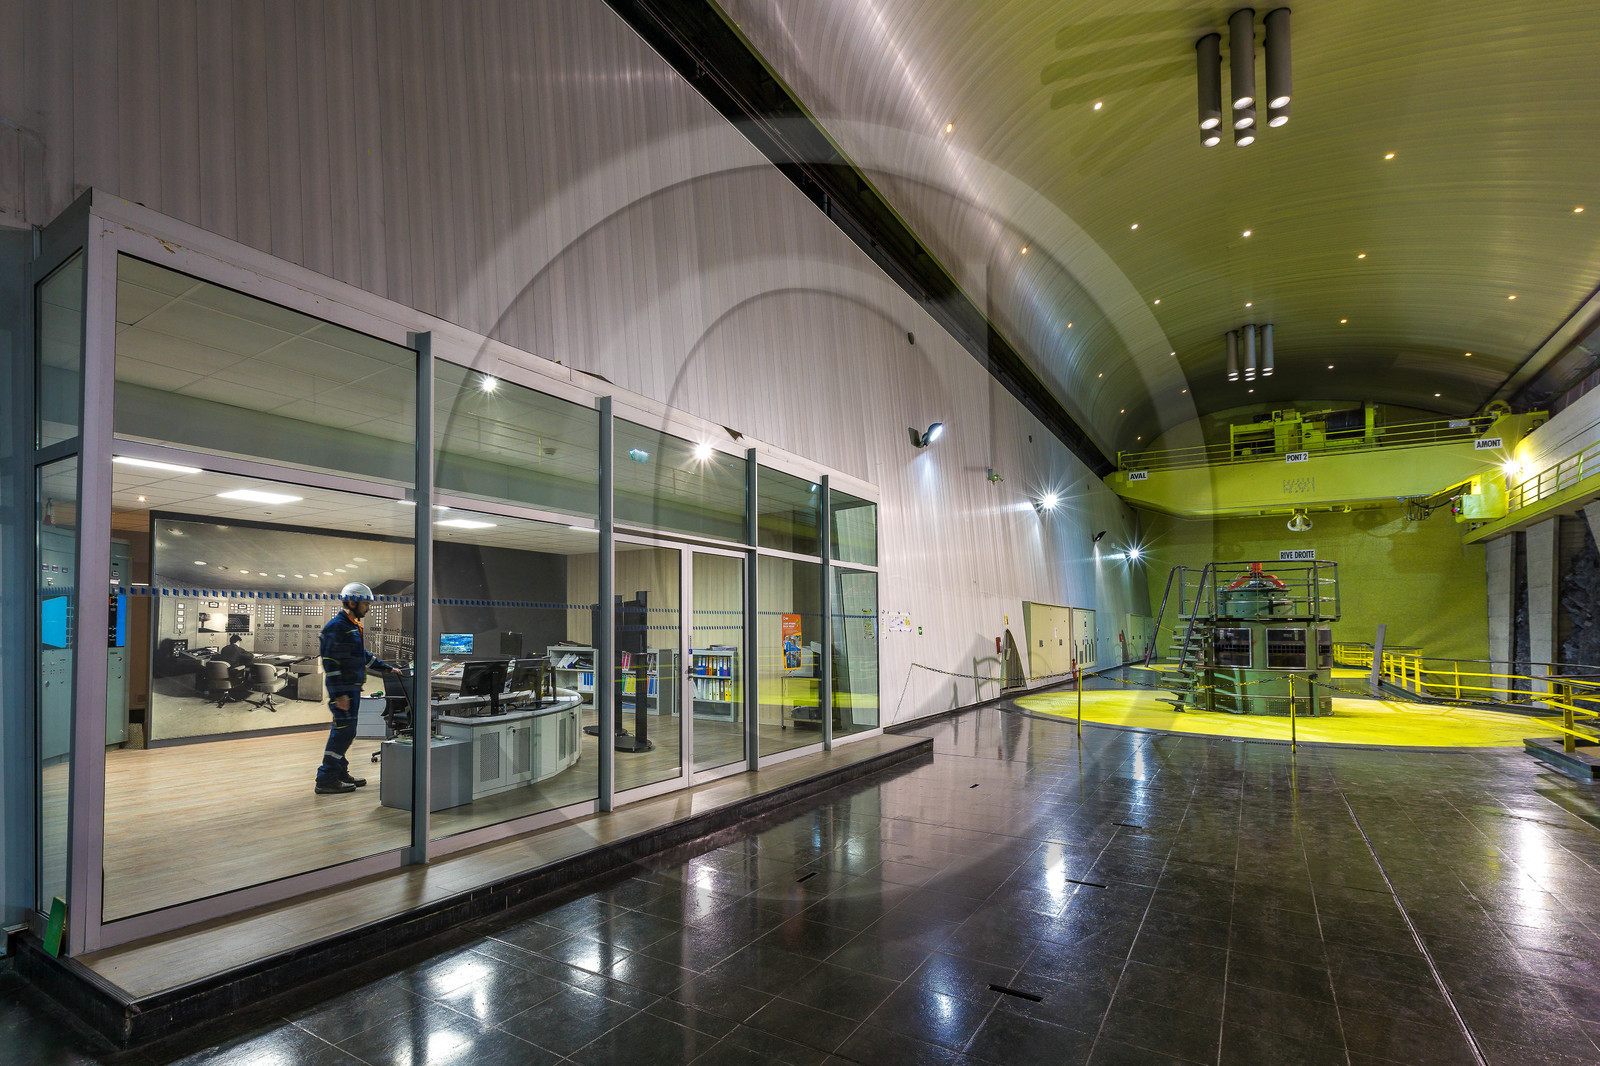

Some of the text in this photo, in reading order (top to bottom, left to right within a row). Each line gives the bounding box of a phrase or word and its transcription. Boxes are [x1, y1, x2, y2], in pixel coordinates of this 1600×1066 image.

[1476, 439, 1501, 449] AMONT
[1286, 453, 1302, 462] PONT
[1130, 472, 1147, 480] AVAL
[1280, 550, 1315, 560] RIVE DROITE
